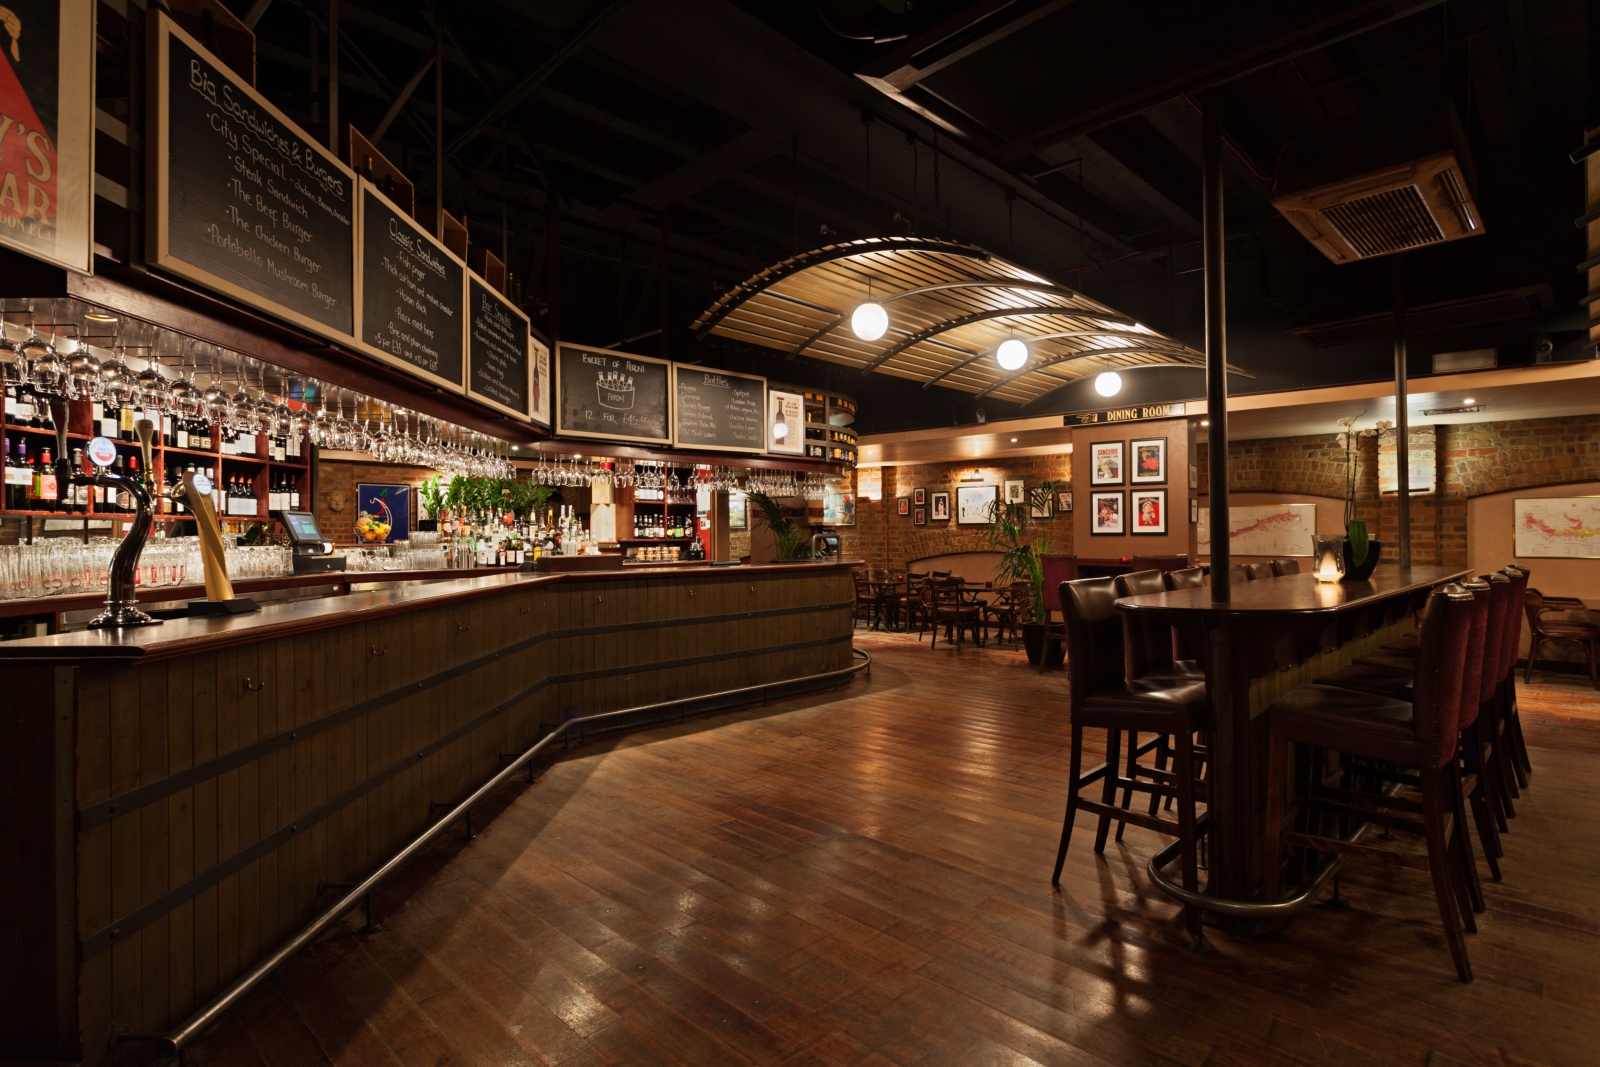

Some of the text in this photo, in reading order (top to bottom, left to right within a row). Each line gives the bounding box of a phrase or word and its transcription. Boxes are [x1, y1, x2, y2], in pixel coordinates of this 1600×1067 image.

[191, 60, 343, 196] Big Sandwiches & Burgers
[211, 113, 238, 151] City
[242, 135, 287, 181] Special
[235, 156, 308, 218] Steak Sandwich
[231, 178, 313, 243] The Beef Burger
[29, 222, 51, 242] EC3
[229, 205, 322, 274] The Chicken Burger
[389, 218, 446, 277] Classic Sandwiches
[211, 223, 338, 310] Portobello Mushroom Burger
[383, 256, 398, 278] Thick
[399, 251, 411, 270] Fish
[415, 300, 427, 315] duck
[389, 321, 401, 338] Brie
[400, 333, 411, 344] and
[582, 353, 607, 367] BUCKET
[704, 373, 729, 387] Bottles
[585, 410, 595, 420] 12
[1107, 405, 1171, 422] DINING ROOM
